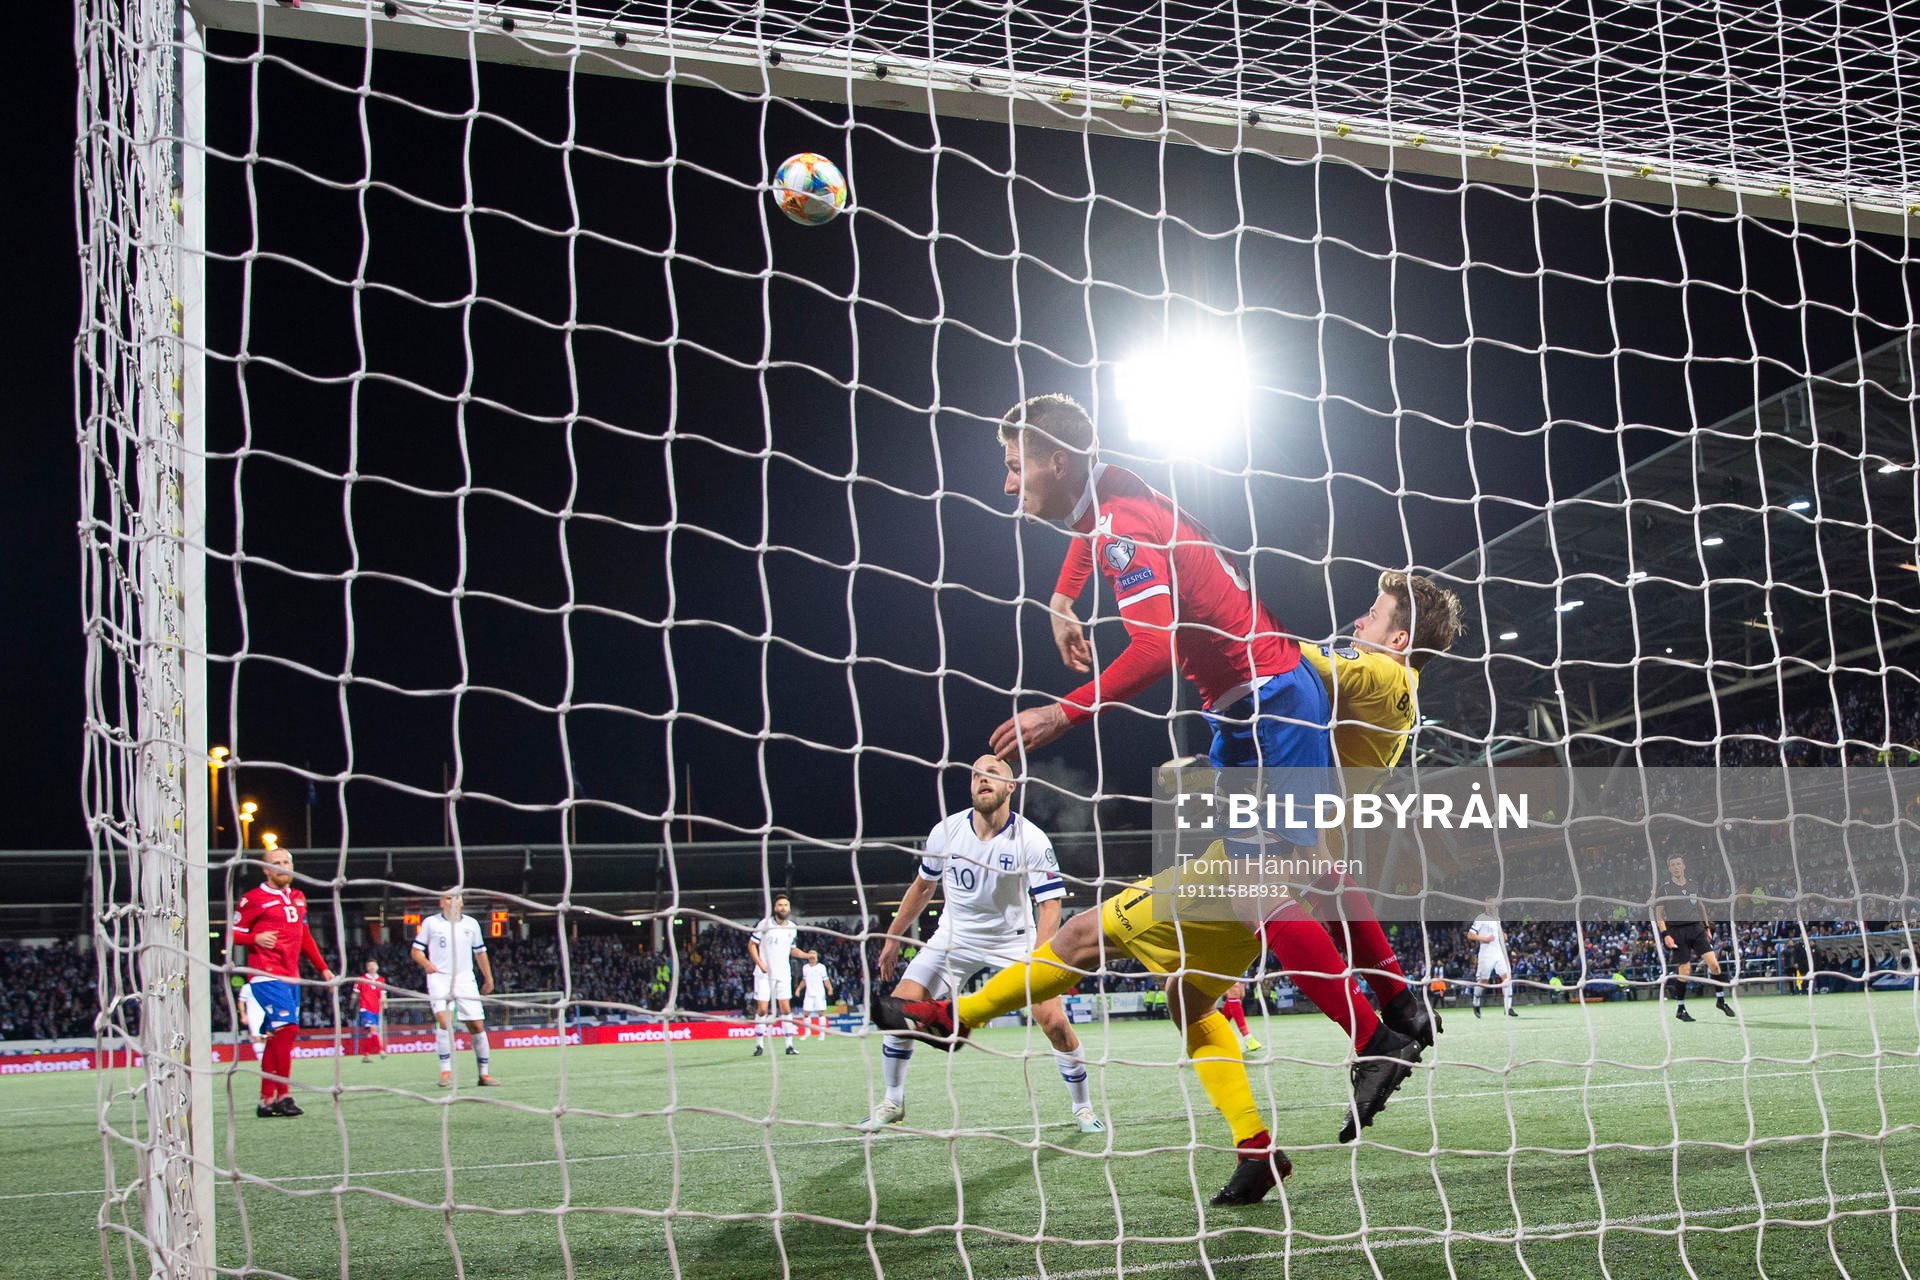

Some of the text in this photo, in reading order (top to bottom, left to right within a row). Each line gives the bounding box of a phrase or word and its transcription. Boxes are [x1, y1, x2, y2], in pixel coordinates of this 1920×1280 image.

[1121, 570, 1153, 587] RESPECT
[951, 866, 975, 890] 10
[283, 905, 299, 923] 13
[439, 936, 447, 948] 8
[386, 1038, 465, 1053] motot
[1, 1057, 90, 1074] motonet
